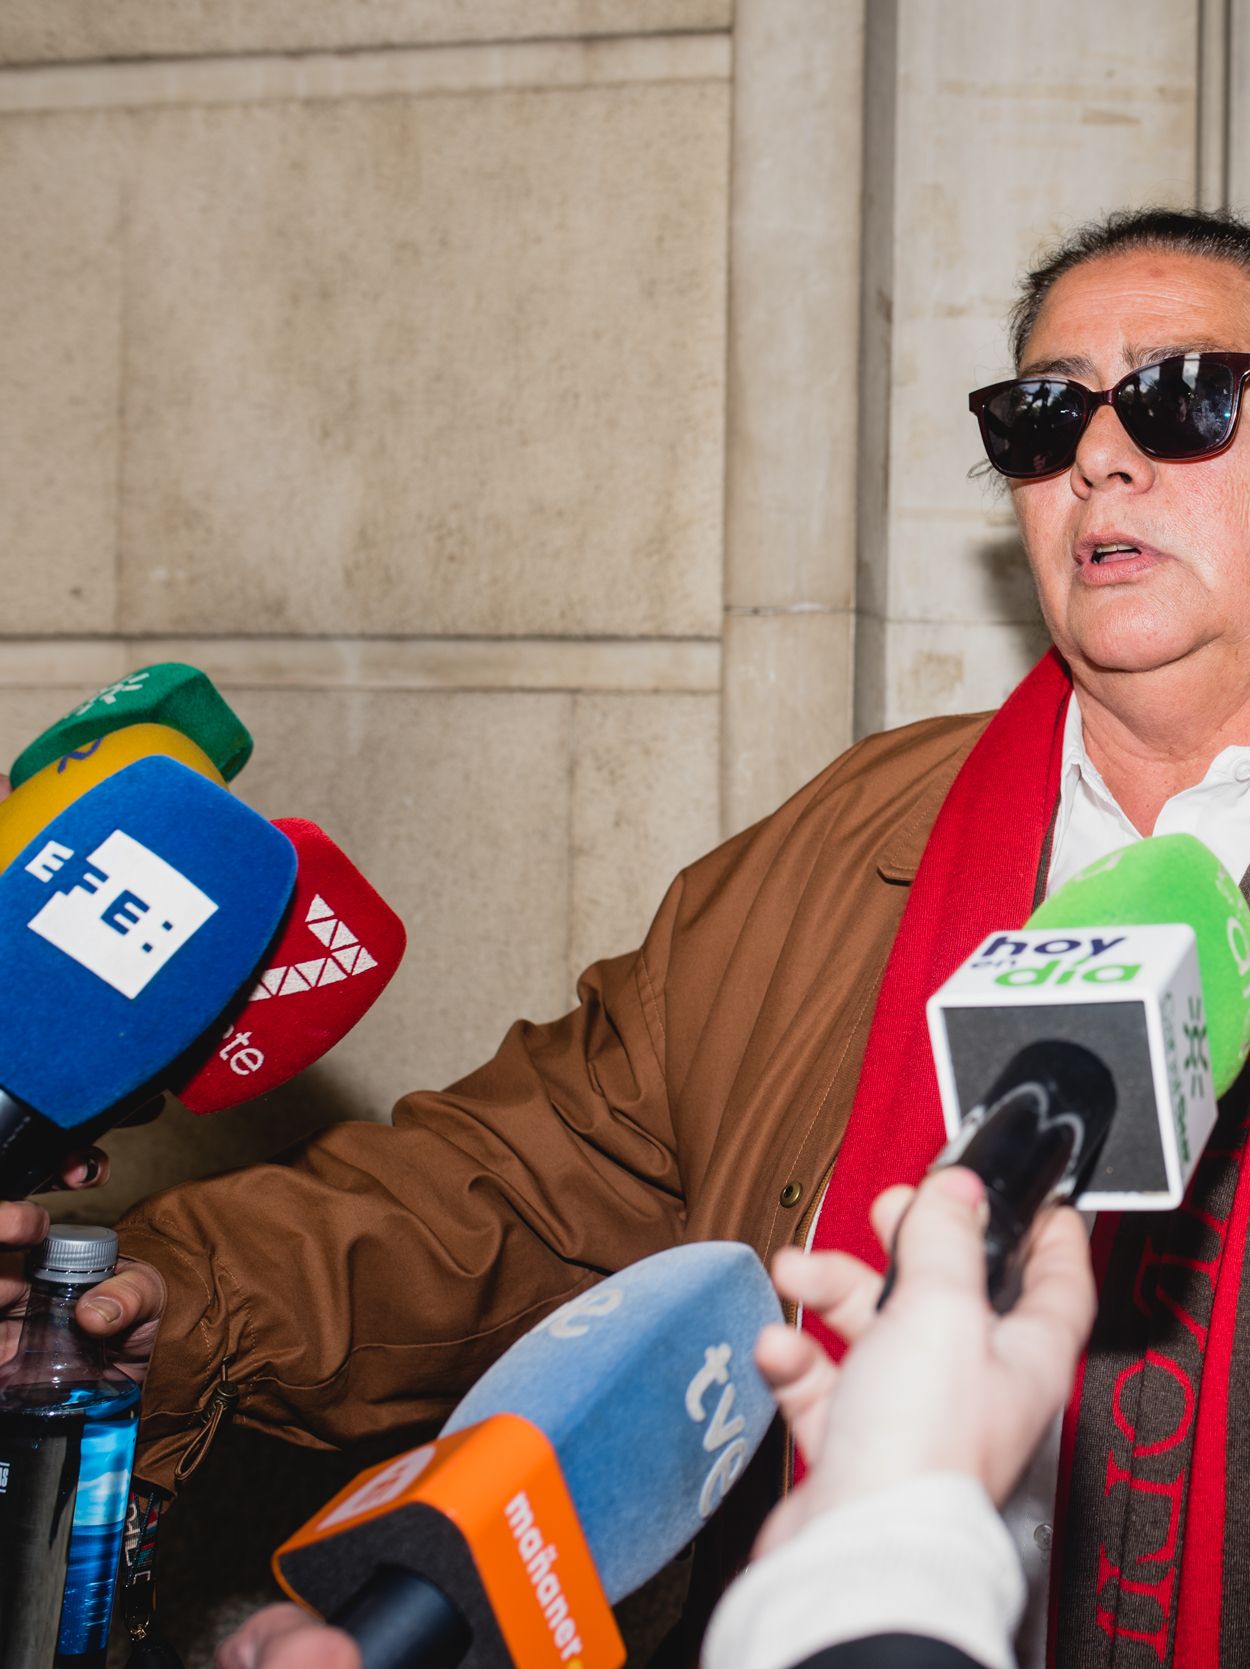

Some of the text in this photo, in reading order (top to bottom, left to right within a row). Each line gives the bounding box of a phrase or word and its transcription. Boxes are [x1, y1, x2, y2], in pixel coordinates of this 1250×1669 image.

[981, 935, 1127, 959] hoy
[970, 954, 1144, 988] en día
[219, 1024, 265, 1077] te
[684, 1342, 747, 1518] tve
